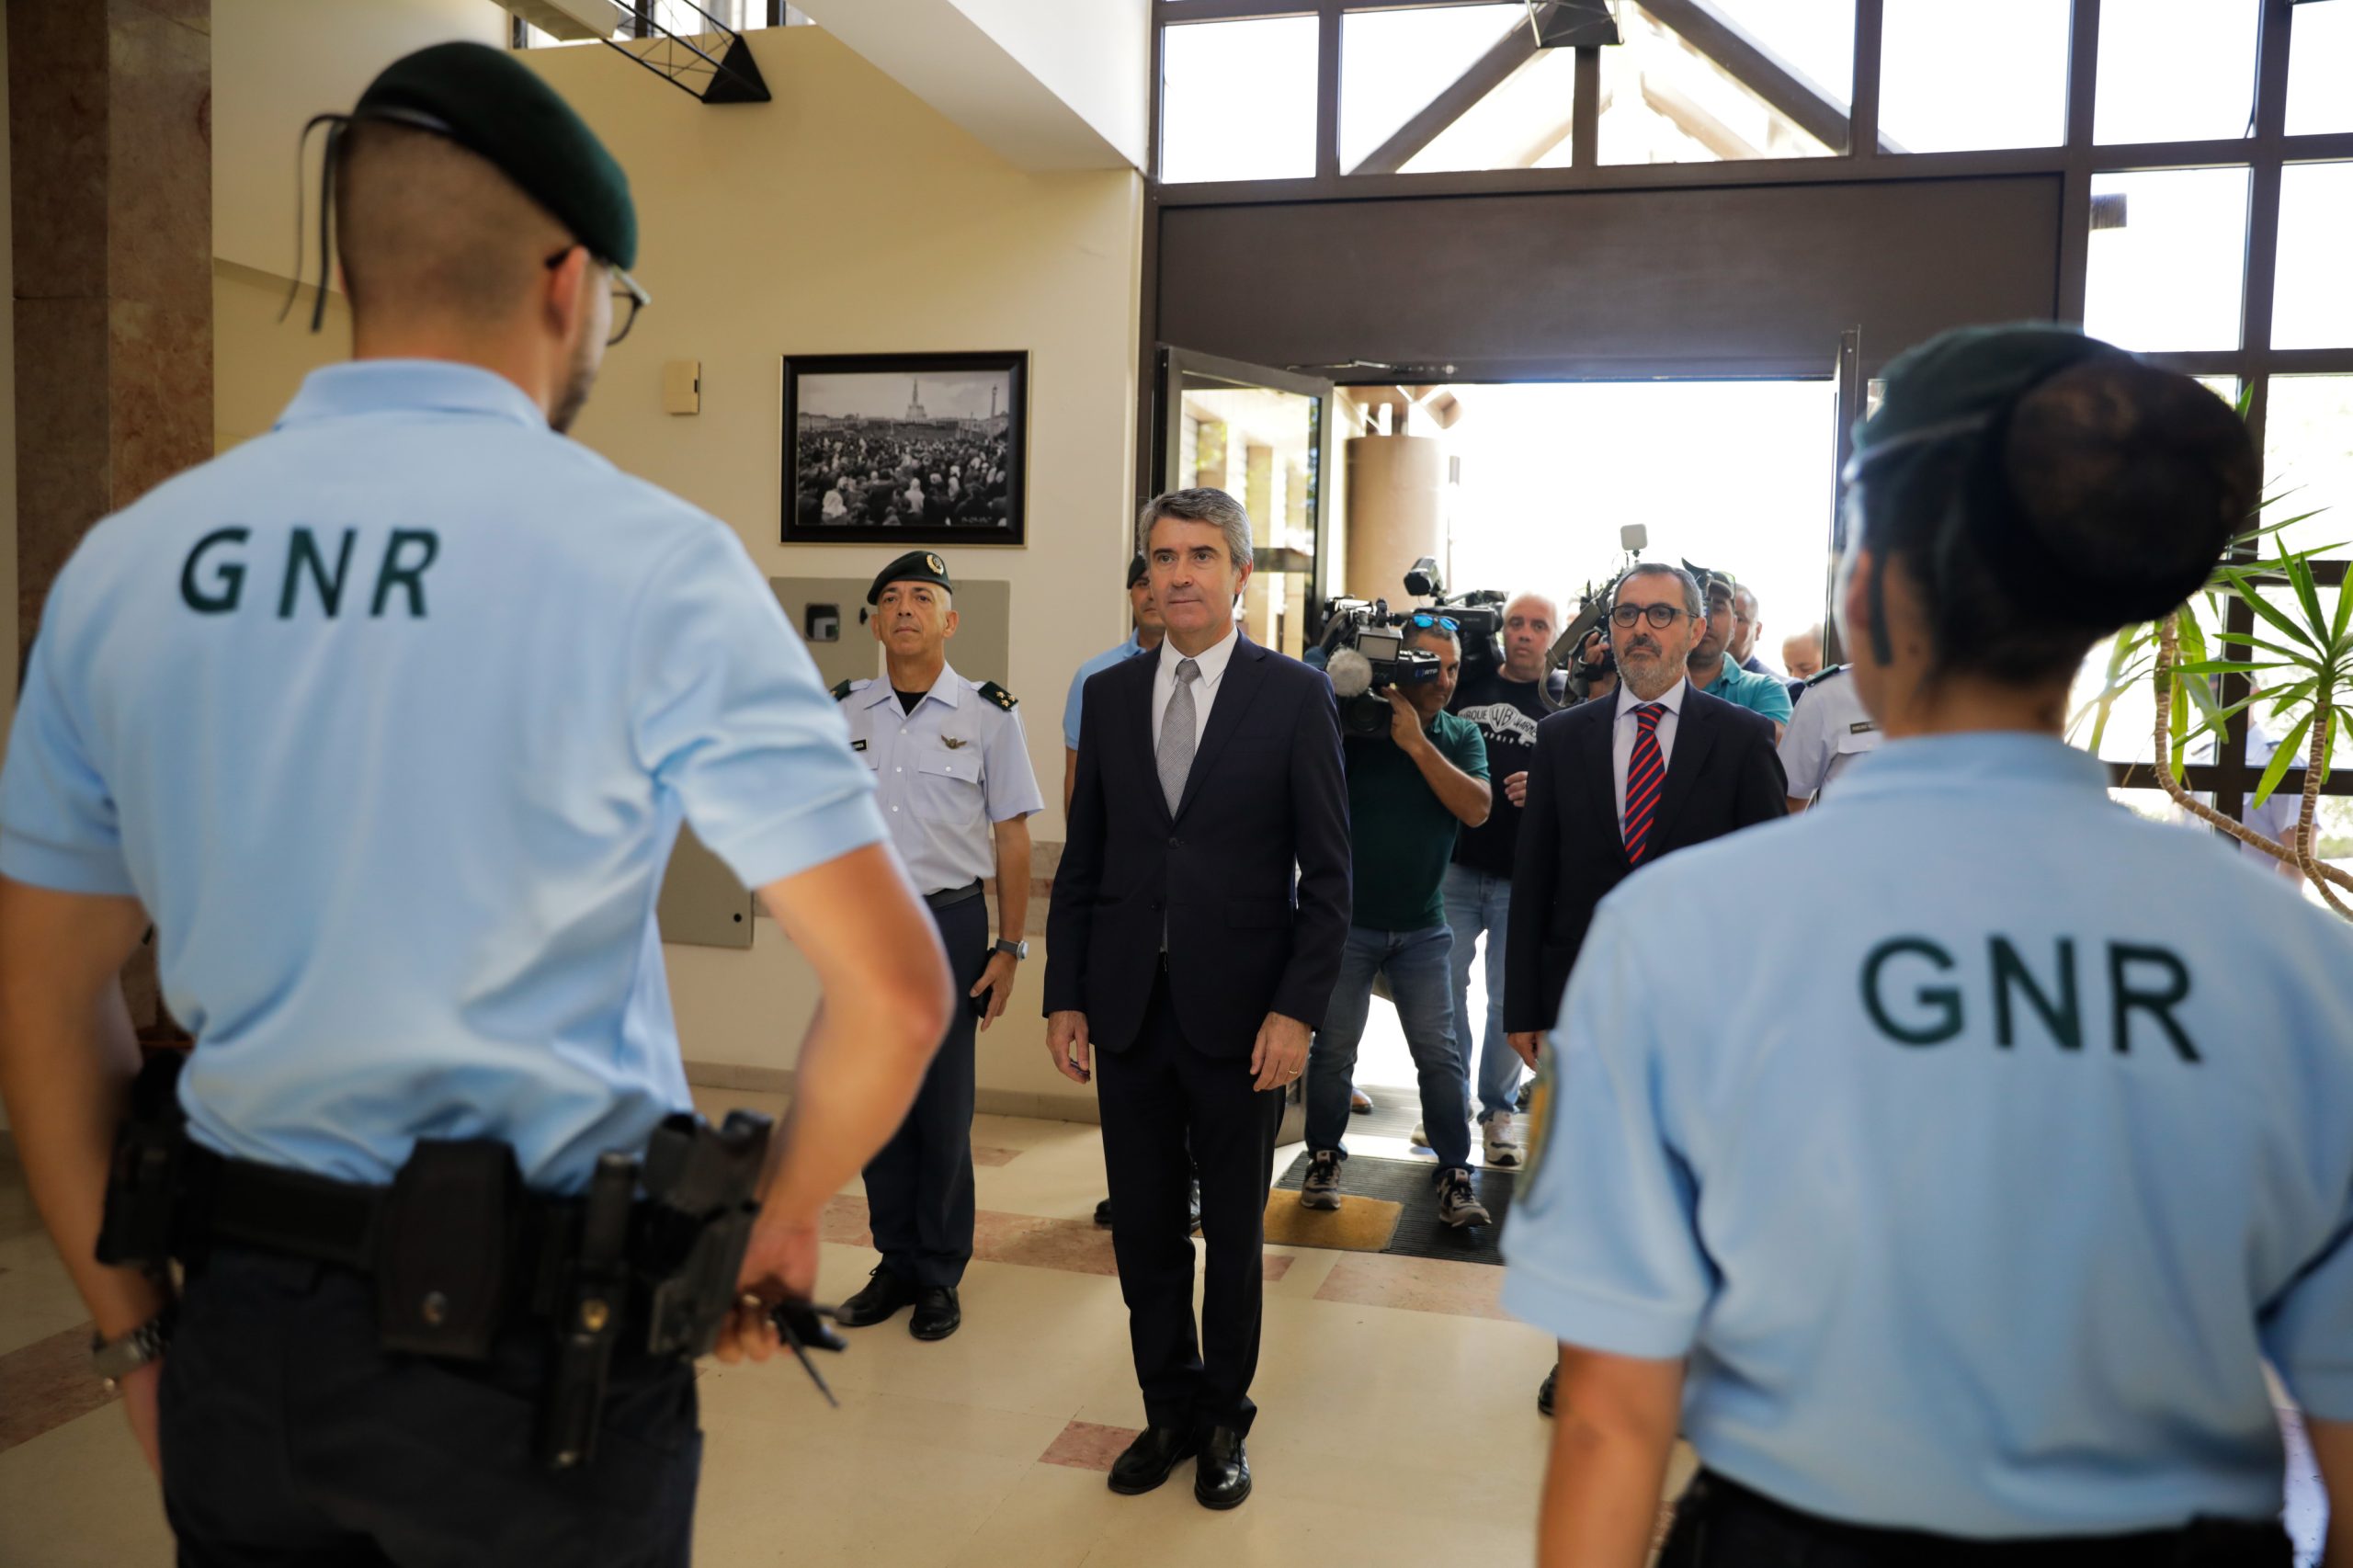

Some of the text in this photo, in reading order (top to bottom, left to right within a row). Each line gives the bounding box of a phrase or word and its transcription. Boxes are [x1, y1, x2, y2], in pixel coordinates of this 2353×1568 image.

[179, 526, 440, 619] GNR
[1492, 707, 1514, 728] WB
[1859, 933, 2203, 1064] GNR
